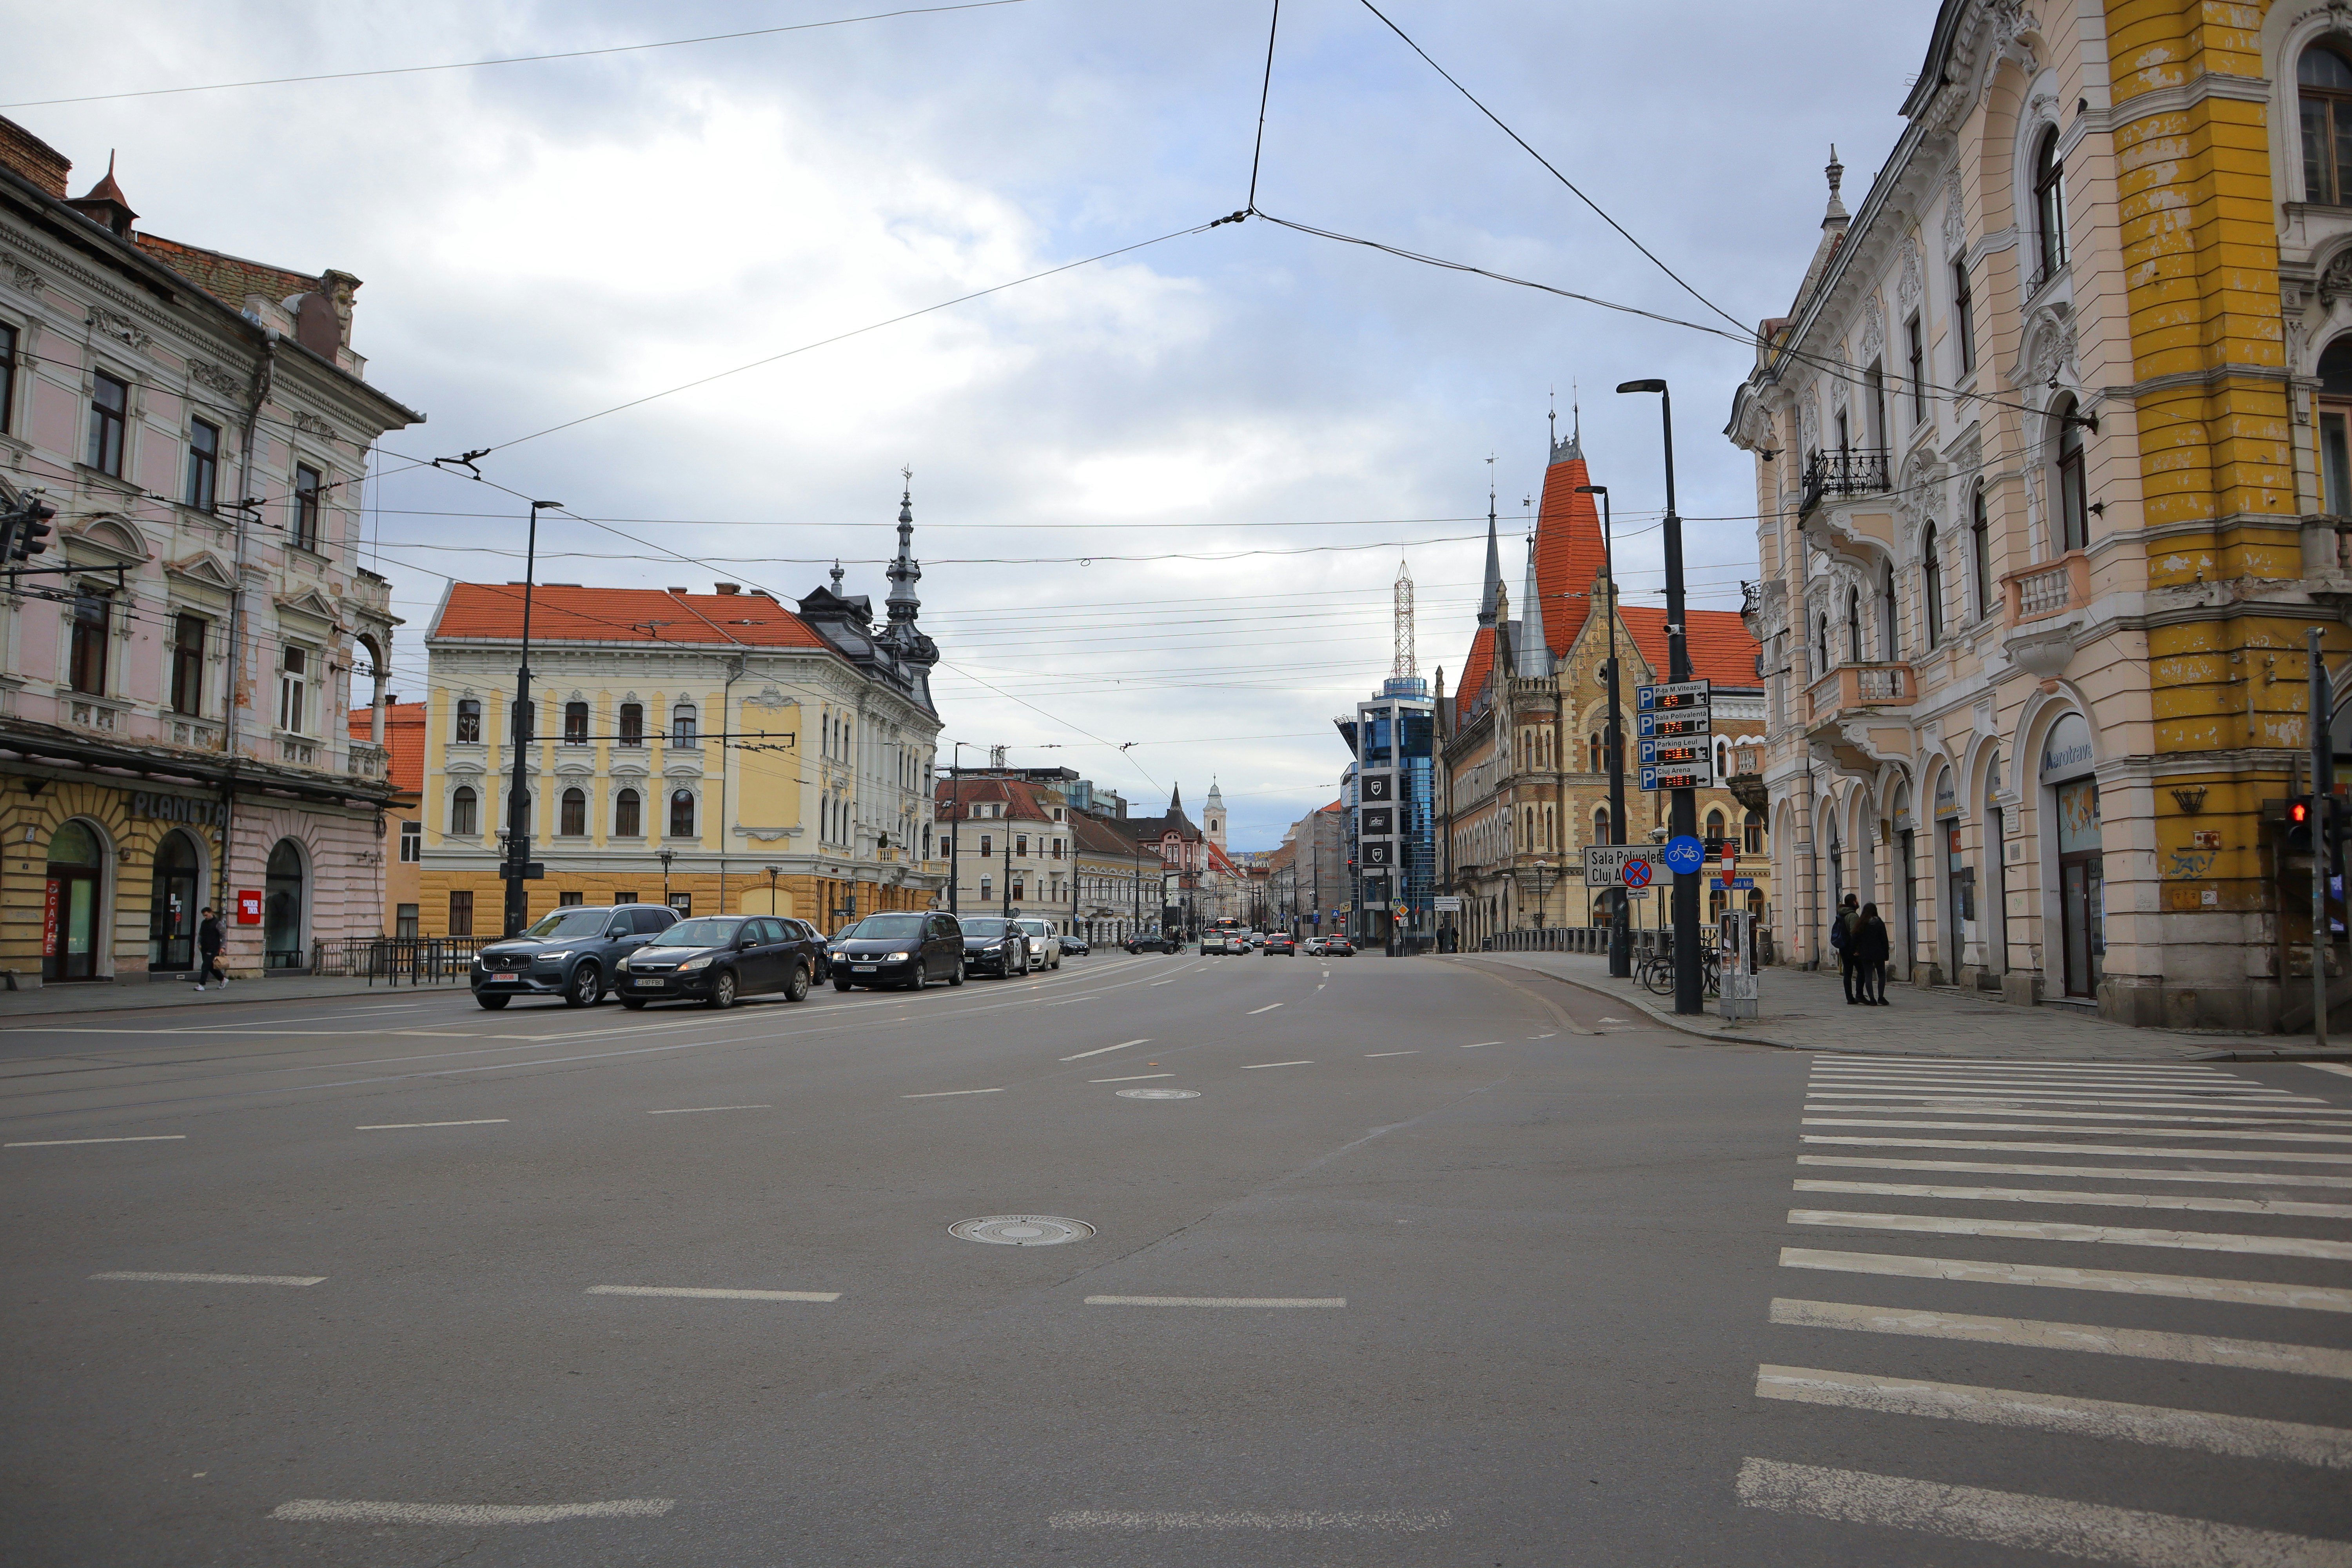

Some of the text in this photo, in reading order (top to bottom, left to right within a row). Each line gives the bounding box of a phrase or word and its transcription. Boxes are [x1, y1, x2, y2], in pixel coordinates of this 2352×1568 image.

[1671, 711, 1706, 719] Polivalentă
[134, 791, 227, 827] PLANETA
[1592, 851, 1613, 864] Sala
[1592, 868, 1611, 884] Cluj
[46, 897, 56, 953] CAFFE
